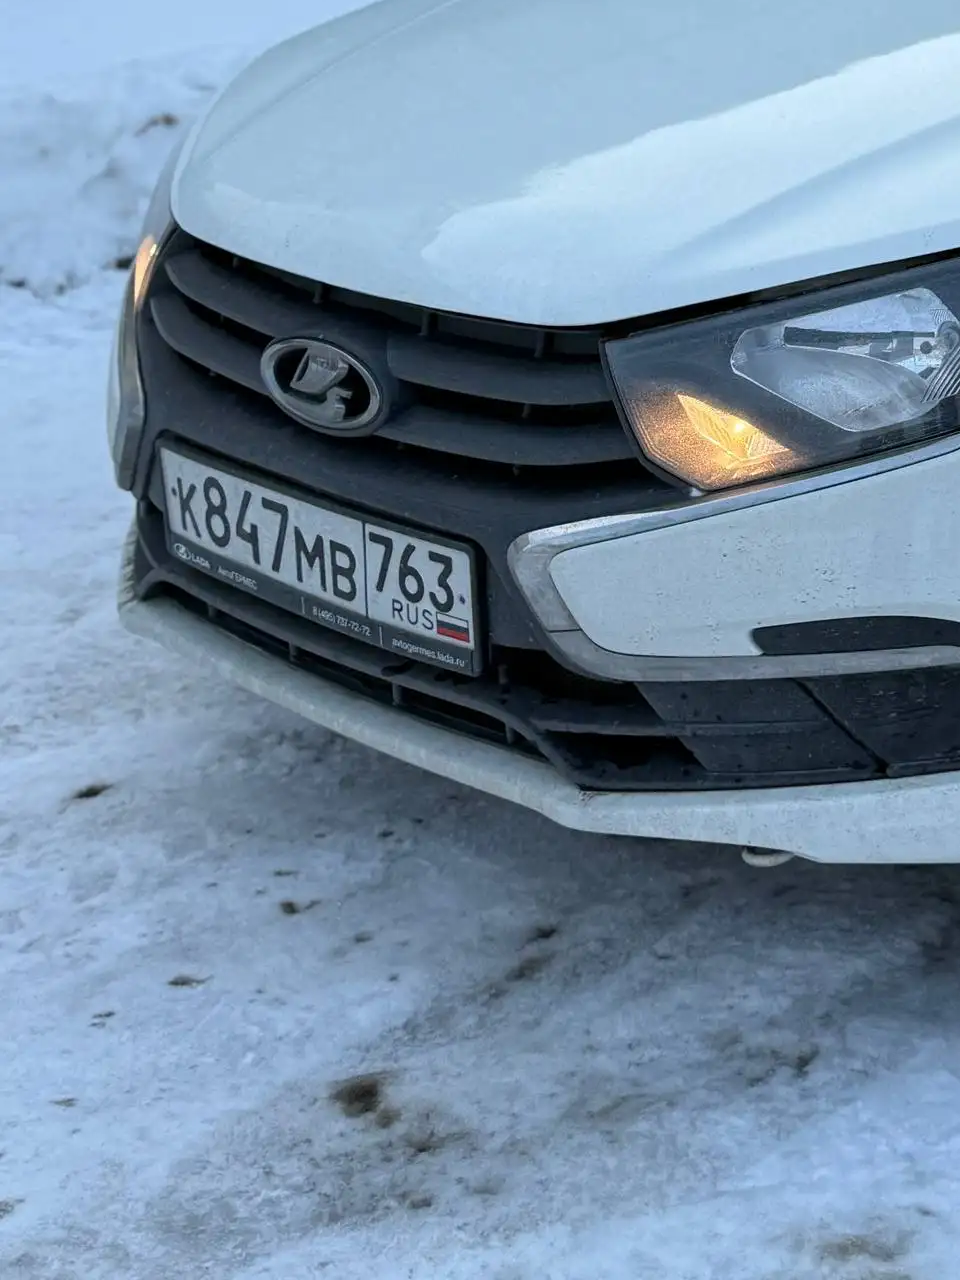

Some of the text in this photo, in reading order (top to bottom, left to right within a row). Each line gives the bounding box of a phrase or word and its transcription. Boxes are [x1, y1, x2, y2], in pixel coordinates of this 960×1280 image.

[191, 552, 211, 569] LADA
[369, 532, 454, 611] 763
[392, 599, 434, 630] RUS
